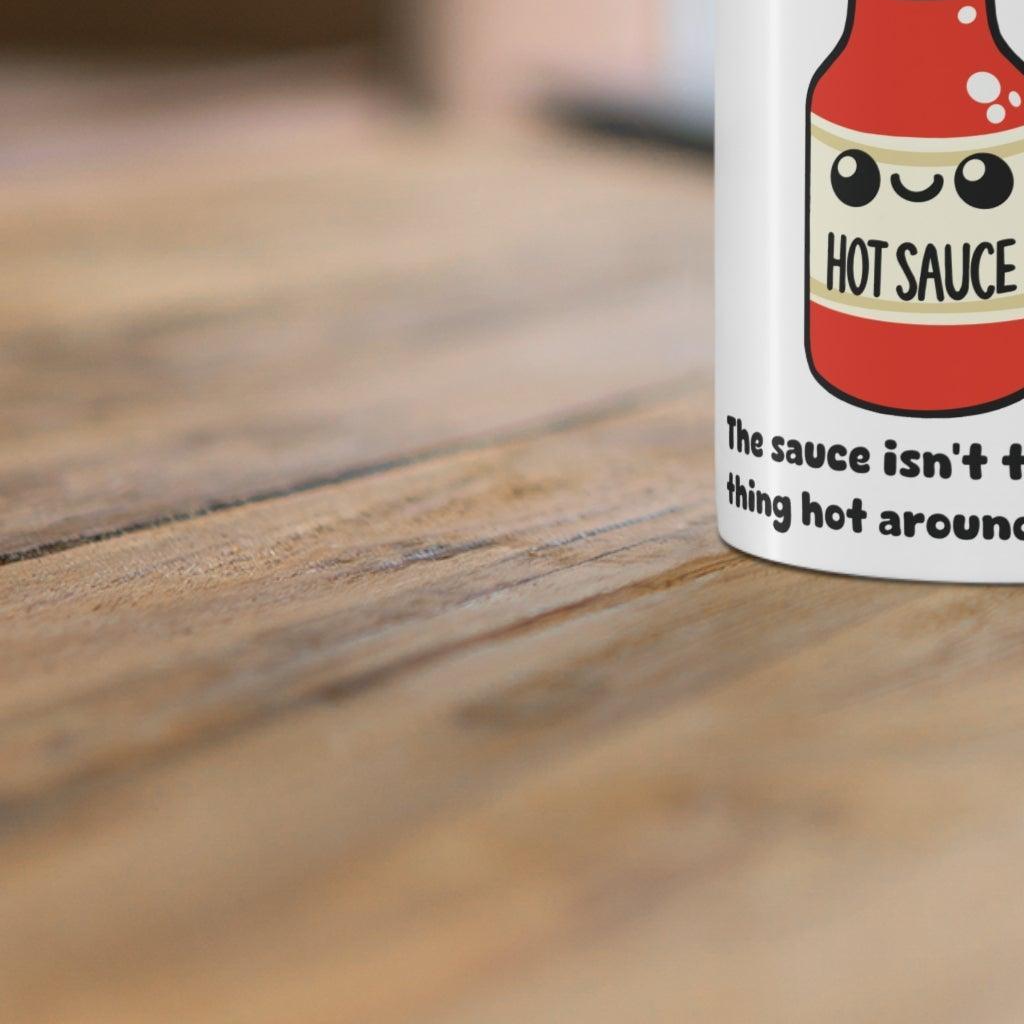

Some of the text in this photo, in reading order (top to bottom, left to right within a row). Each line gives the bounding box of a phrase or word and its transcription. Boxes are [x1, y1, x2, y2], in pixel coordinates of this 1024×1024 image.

[826, 231, 1018, 302] HOT SAUCE
[726, 415, 764, 458] The
[771, 436, 871, 474] sauce
[883, 439, 988, 481] isn't
[726, 472, 792, 534] thing
[801, 491, 868, 534] hot
